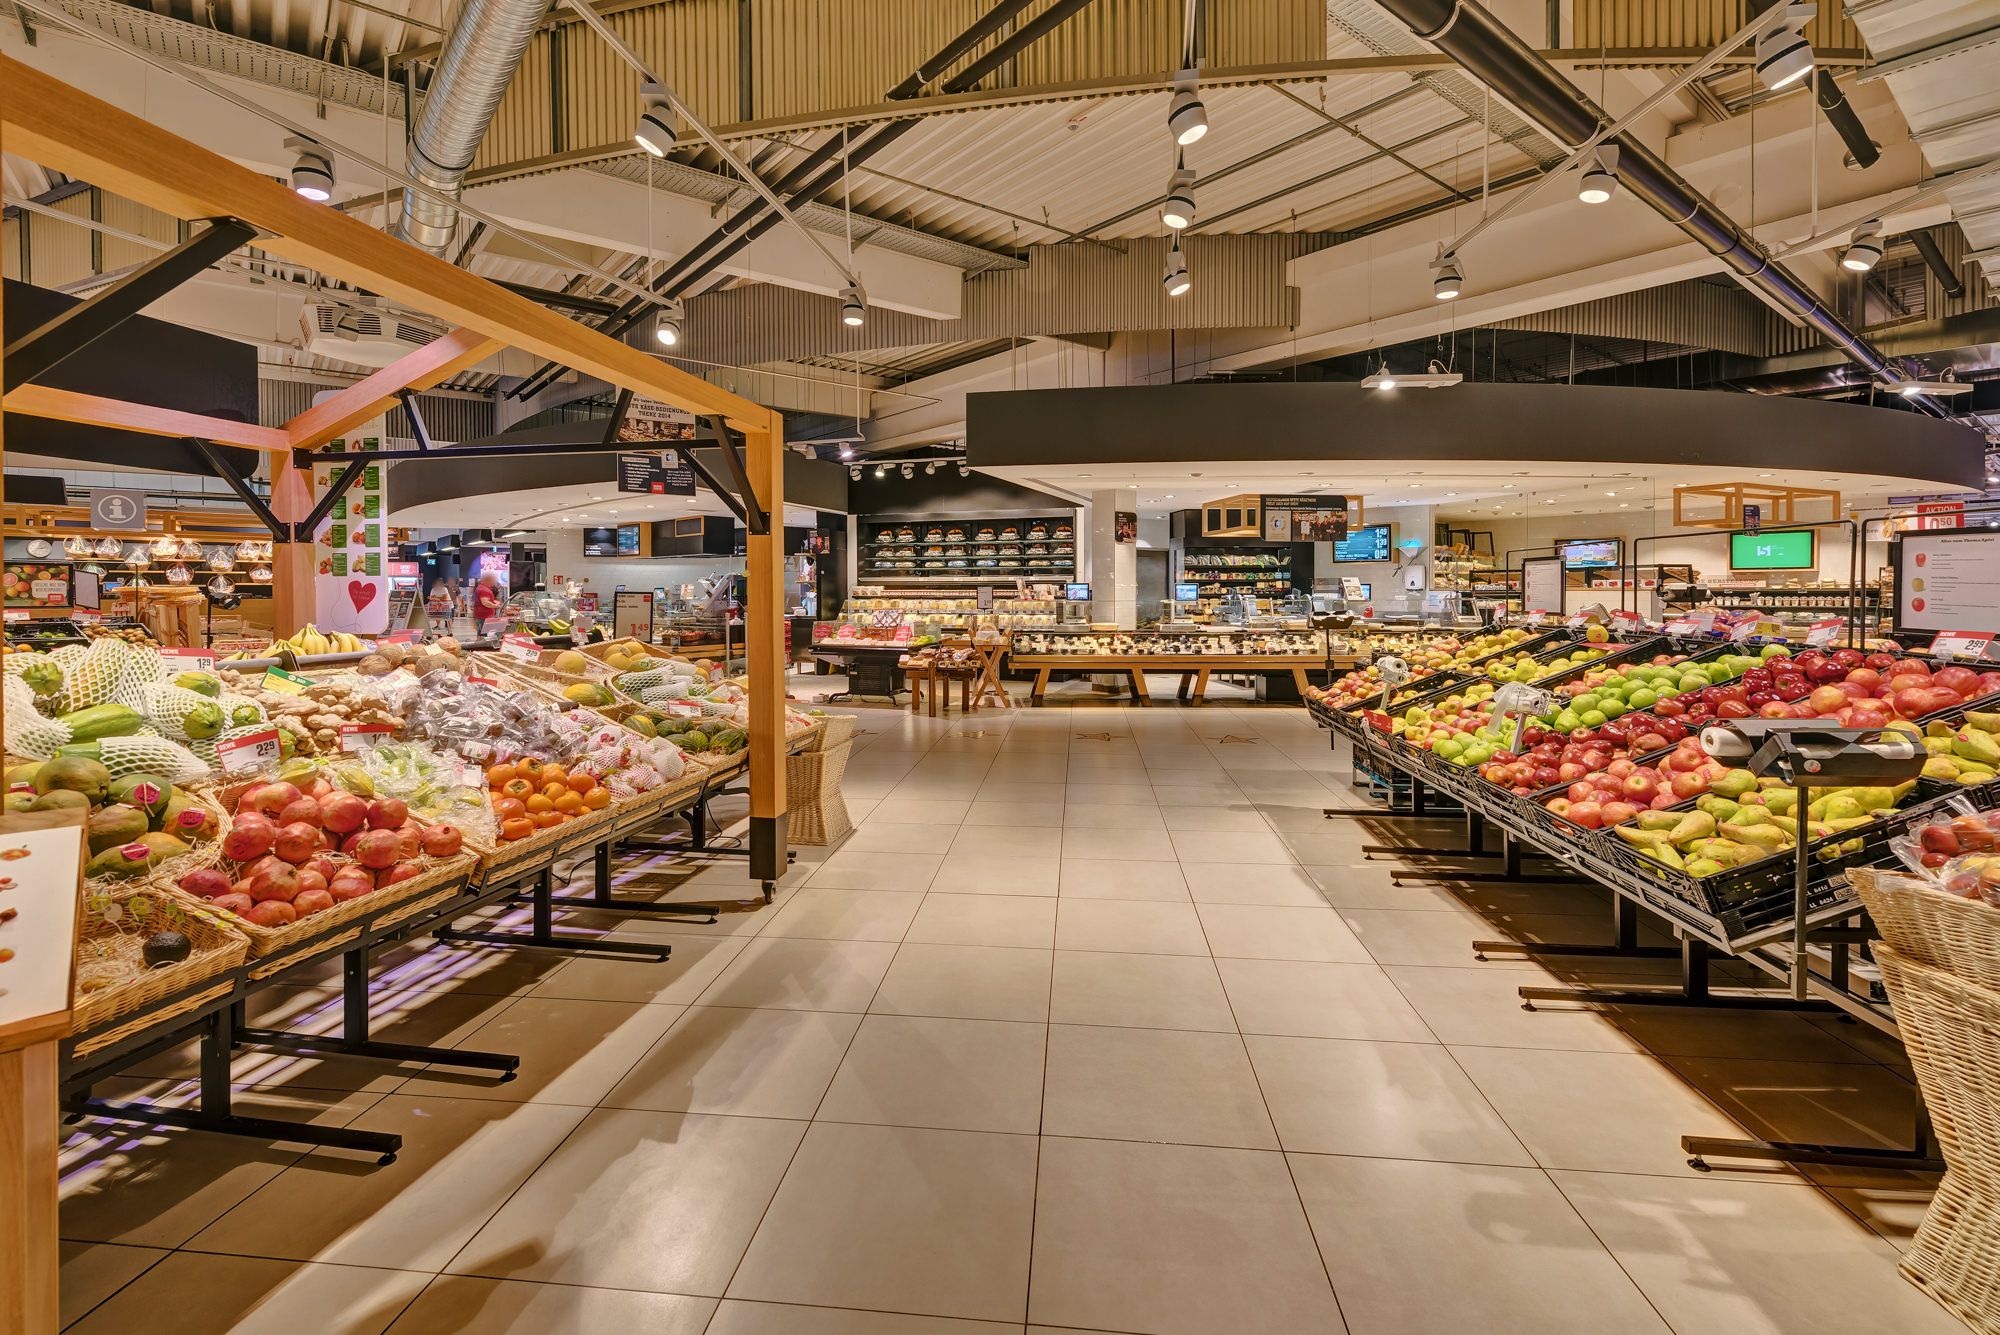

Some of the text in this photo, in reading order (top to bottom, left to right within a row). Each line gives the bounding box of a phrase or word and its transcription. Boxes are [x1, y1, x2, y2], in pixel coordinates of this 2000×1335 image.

[1964, 640, 1986, 651] 2.99
[196, 657, 211, 669] 1.29
[218, 741, 236, 751] REWE
[256, 740, 275, 757] 2.29
